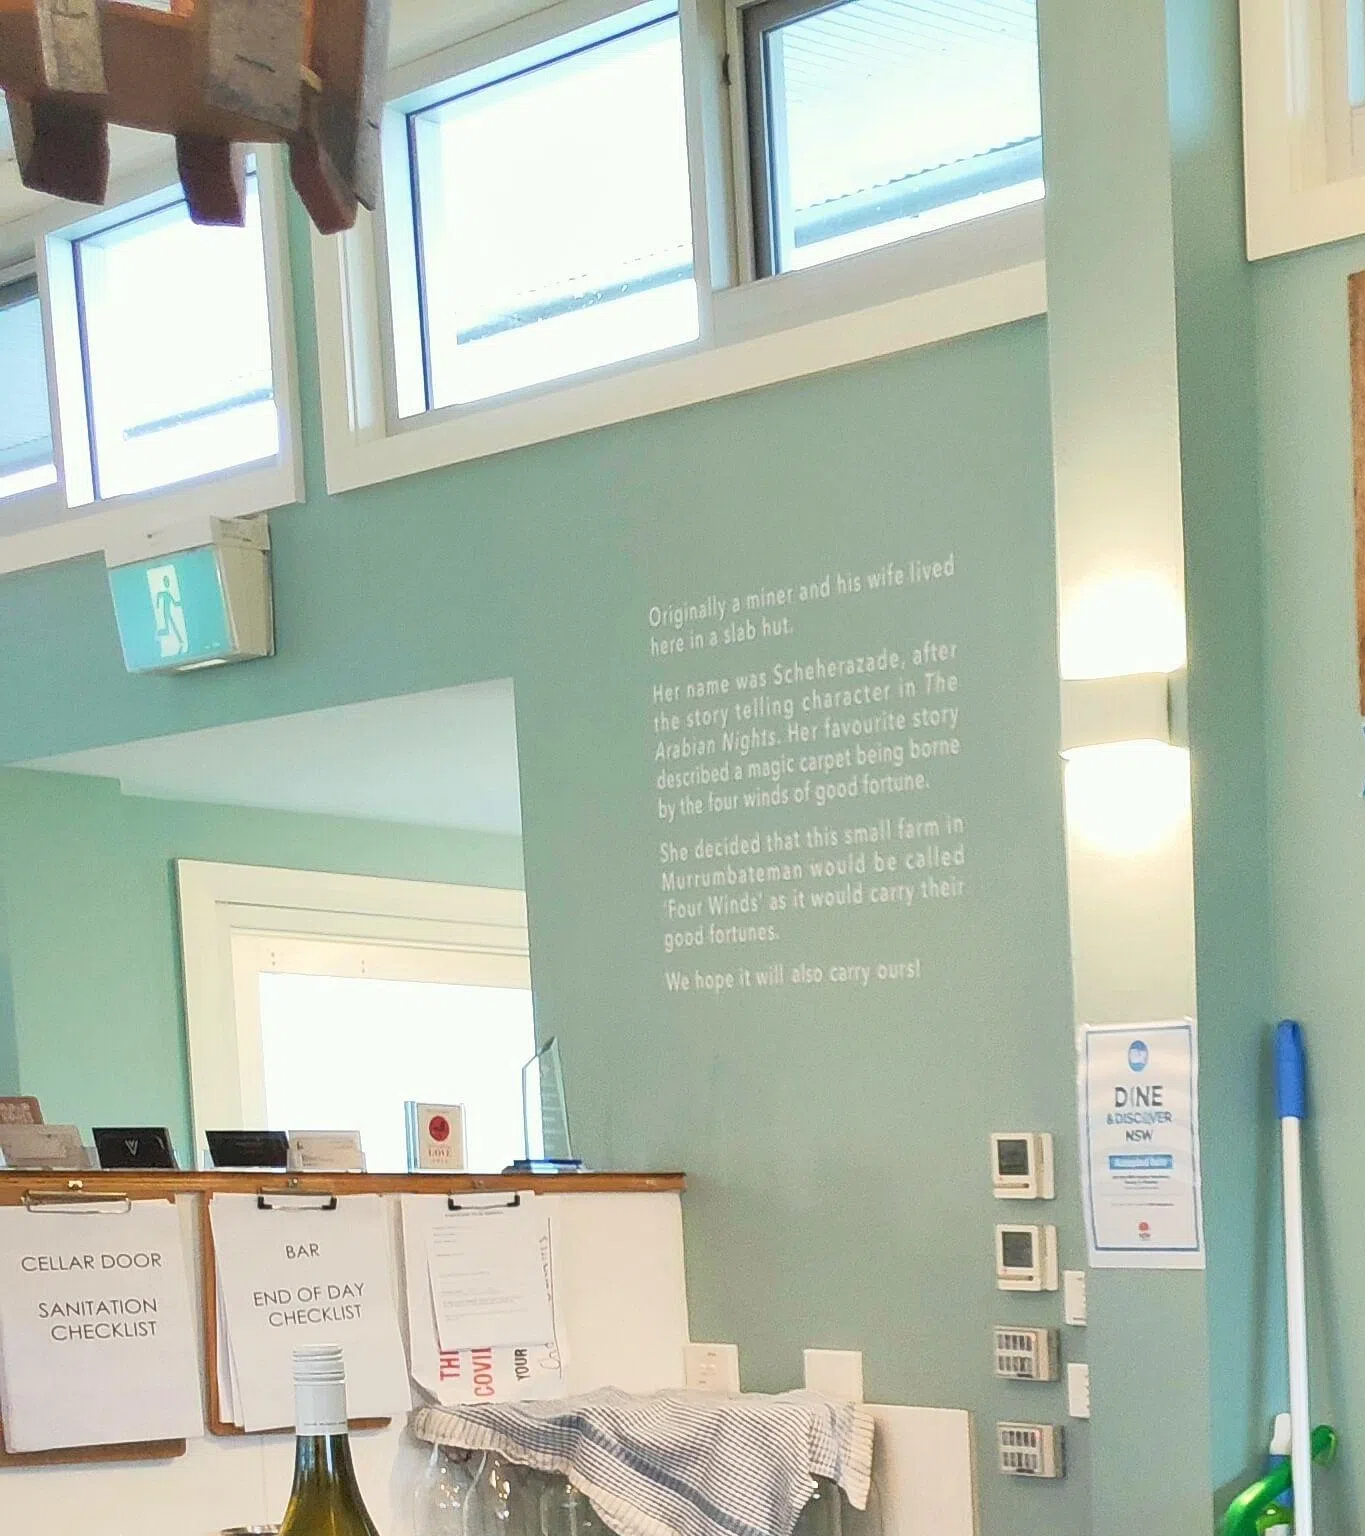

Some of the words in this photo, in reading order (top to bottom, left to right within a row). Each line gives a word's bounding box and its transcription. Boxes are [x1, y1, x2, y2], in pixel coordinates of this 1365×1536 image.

[649, 596, 726, 629] Originally
[732, 597, 740, 613] a
[746, 587, 794, 610] miner
[799, 575, 830, 600] and
[836, 573, 861, 594] his
[867, 562, 904, 589] wife
[909, 553, 955, 583] lived
[651, 635, 684, 657] here
[690, 632, 703, 650] in
[710, 630, 718, 646] a
[724, 619, 756, 645] slab
[653, 683, 680, 704] Her
[687, 677, 729, 698] name
[736, 672, 766, 690] was
[912, 640, 957, 666] after
[654, 714, 679, 732] the
[686, 707, 728, 728] story
[736, 698, 794, 719] telling
[802, 684, 890, 711] character
[901, 679, 916, 698] in
[925, 671, 958, 693] The
[655, 738, 716, 760] Arabian
[788, 724, 818, 742] Her
[825, 712, 905, 739] favourite
[913, 705, 959, 728] story
[657, 765, 729, 789] described
[734, 764, 743, 780] a
[748, 756, 795, 781] magic
[799, 751, 851, 774] carpet
[856, 743, 904, 766] being
[909, 738, 960, 758] borne
[658, 799, 675, 823] by
[681, 797, 703, 814] the
[708, 792, 738, 812] four
[743, 785, 789, 808] winds
[794, 782, 810, 802] of
[815, 779, 857, 806] good
[660, 842, 688, 863] She
[695, 832, 760, 858] decided
[767, 829, 800, 852] that
[806, 825, 838, 850] this
[844, 820, 891, 846] small
[899, 816, 940, 837] farm
[944, 815, 964, 834] in
[662, 863, 802, 891] Murrumbateman
[810, 854, 866, 878] would
[874, 851, 898, 873] be
[905, 847, 965, 871] called
[768, 894, 786, 911] as
[792, 889, 805, 909] it
[810, 884, 863, 907] would
[870, 882, 914, 907] carry
[920, 875, 964, 899] their
[664, 927, 703, 952] good
[665, 972, 689, 992] We
[695, 970, 734, 992] hope
[739, 967, 750, 986] it
[756, 964, 784, 985] will
[791, 962, 823, 984] also
[829, 965, 870, 987] carry
[1115, 1085, 1163, 1107] DINE
[1126, 1129, 1153, 1141] NSW
[21, 1255, 95, 1272] CELLAR
[101, 1252, 162, 1269] DOOR
[286, 1243, 320, 1259] BAR
[38, 1298, 157, 1319] SANITATION
[253, 1288, 292, 1308] END
[297, 1286, 322, 1304] OF
[327, 1282, 366, 1300] DAY
[50, 1320, 157, 1342] CHECKLIST
[269, 1304, 363, 1328] CHECKLIST
[440, 1350, 461, 1381] TH
[472, 1347, 495, 1398] COVI
[515, 1348, 531, 1381] YOUR
